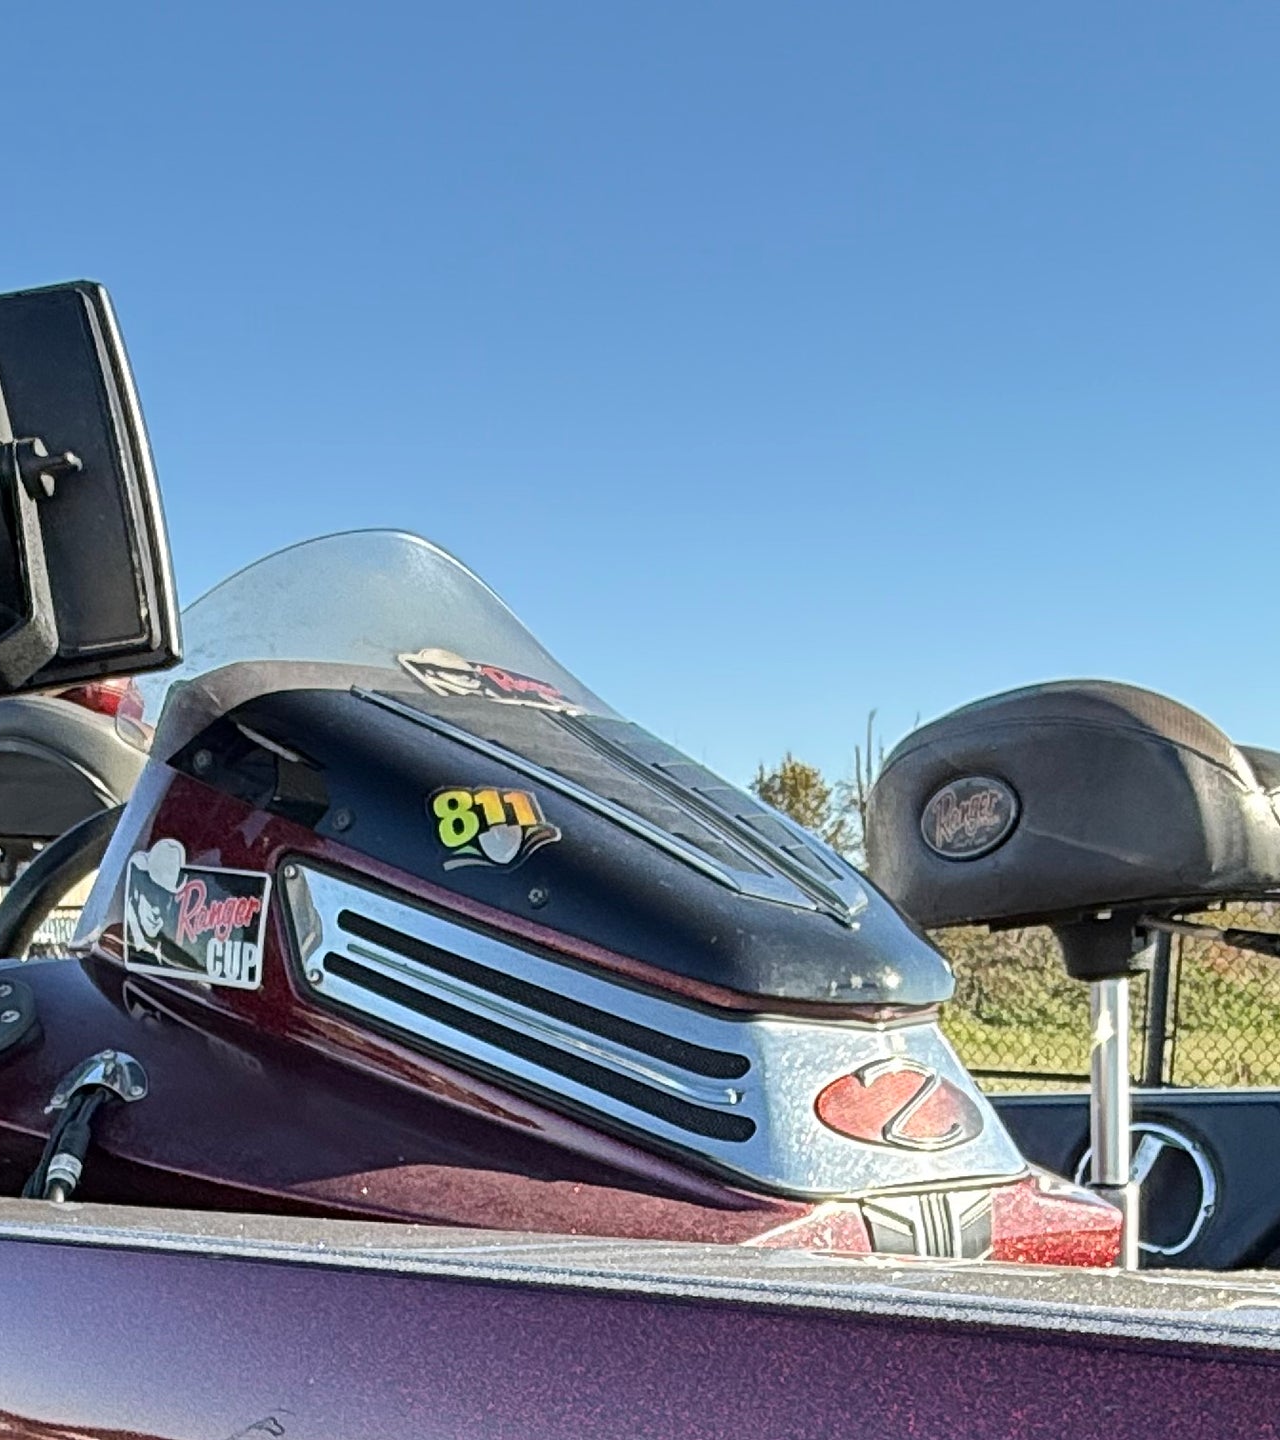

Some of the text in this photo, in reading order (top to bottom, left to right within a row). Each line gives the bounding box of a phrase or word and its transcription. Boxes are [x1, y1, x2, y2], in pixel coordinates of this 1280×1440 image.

[433, 789, 537, 848] 811
[175, 878, 263, 946] Ranger
[206, 937, 259, 982] CUP
